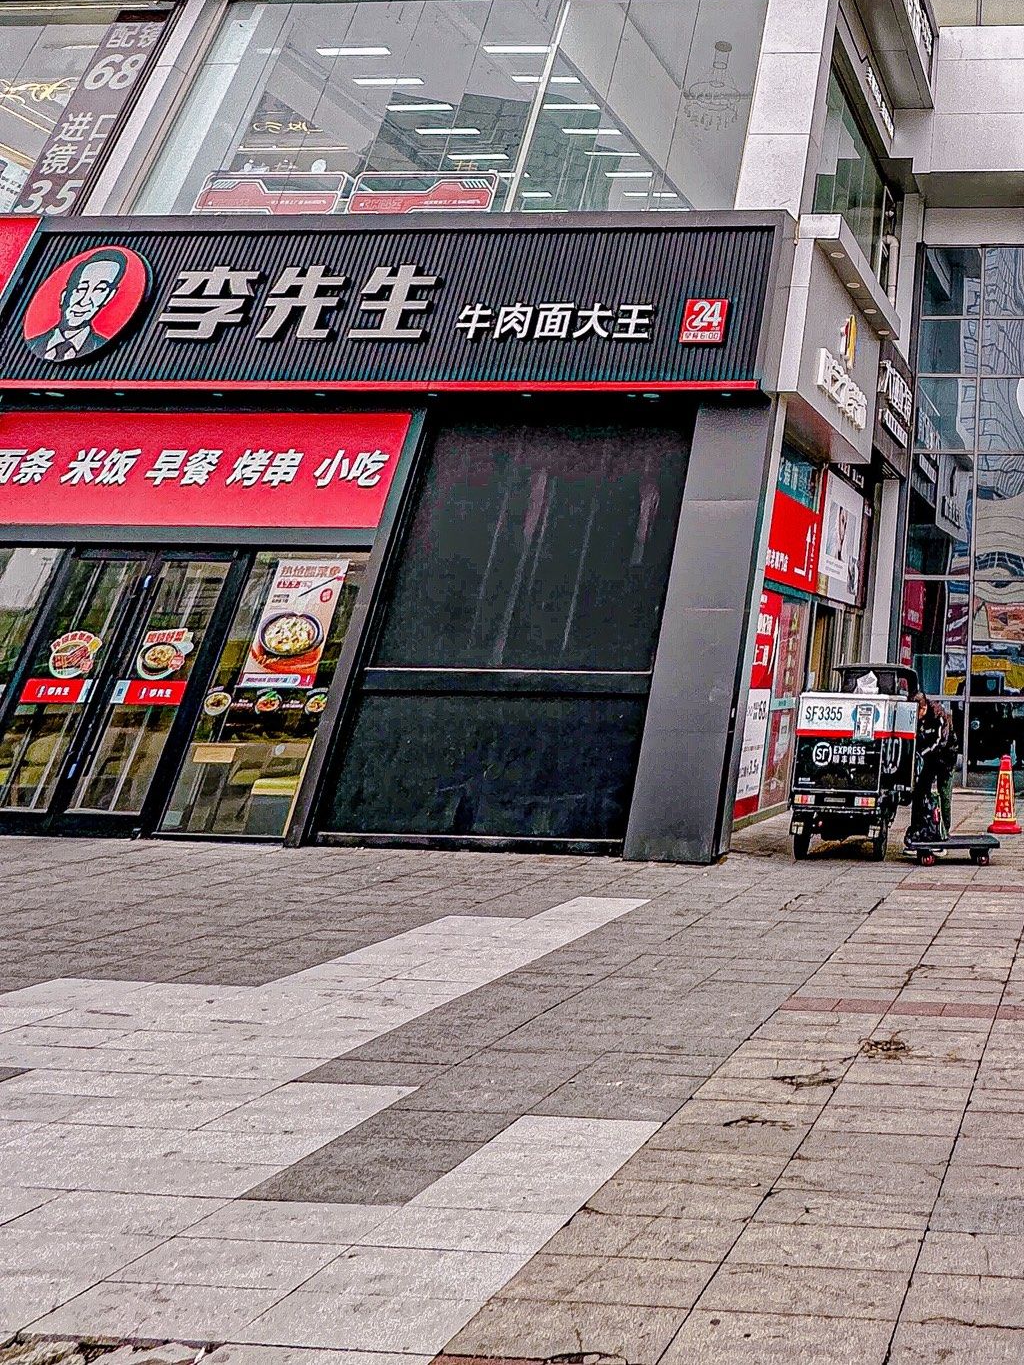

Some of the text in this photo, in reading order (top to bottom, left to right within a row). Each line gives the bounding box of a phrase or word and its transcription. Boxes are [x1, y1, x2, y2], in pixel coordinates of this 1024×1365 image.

[83, 53, 149, 90] 68
[53, 112, 118, 142] 进口
[13, 180, 84, 214] 3.5
[158, 265, 653, 340] 李先生 牛肉面大王
[691, 300, 722, 327] 24
[60, 448, 144, 485] 米饭
[145, 448, 225, 485] 早餐
[226, 449, 303, 486] 烤串
[313, 449, 390, 487] 小吃
[805, 705, 843, 722] SF3355
[833, 745, 867, 756] EXPRESS
